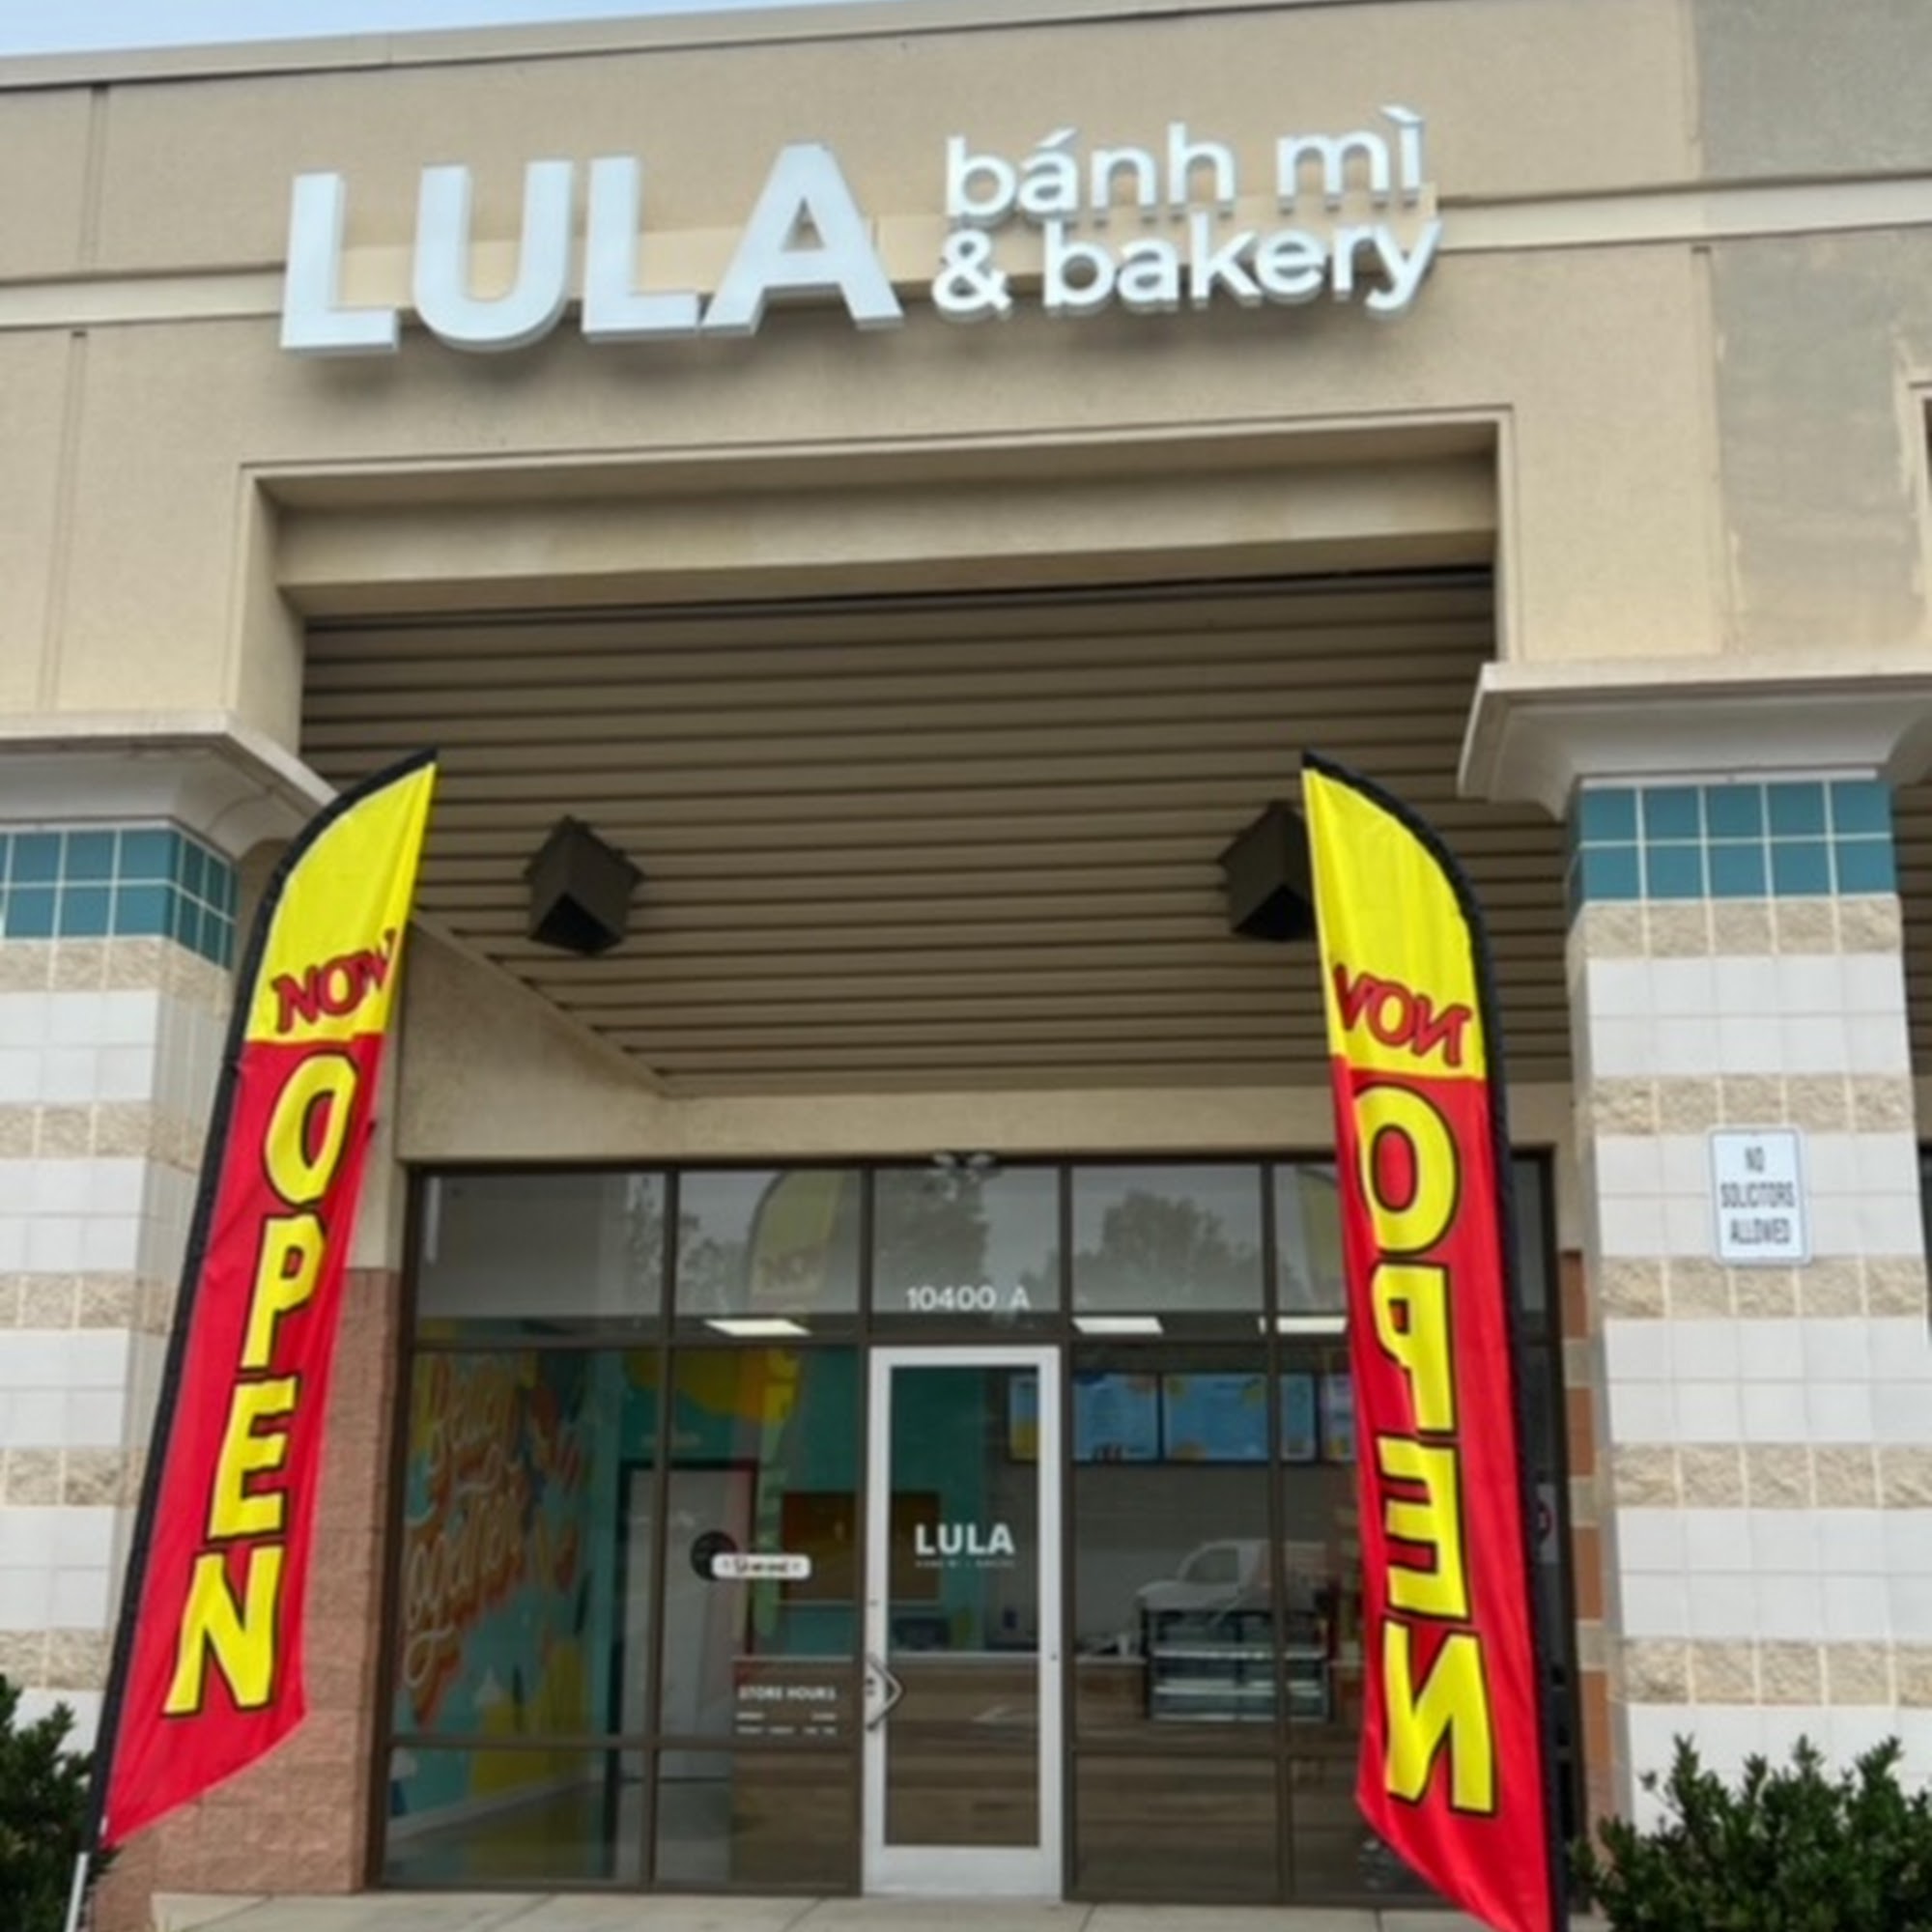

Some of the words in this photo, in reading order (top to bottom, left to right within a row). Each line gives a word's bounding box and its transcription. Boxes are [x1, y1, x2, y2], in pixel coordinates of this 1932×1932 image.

[946, 122, 1236, 221] bánh
[1276, 105, 1424, 199] mì
[280, 142, 902, 354] LULA
[931, 228, 1012, 314] &
[1042, 212, 1442, 311] bakery
[270, 927, 397, 1035] NOW
[1744, 1146, 1766, 1173] NO
[1720, 1180, 1796, 1208] SOLICITORS
[1730, 1217, 1790, 1245] ALLOWED
[906, 1284, 998, 1312] 10400
[1010, 1285, 1031, 1311] A
[161, 1050, 359, 1719] OPEN
[914, 1522, 1015, 1555] LULA
[737, 1685, 782, 1700] STORE
[786, 1685, 837, 1701] HOURS
